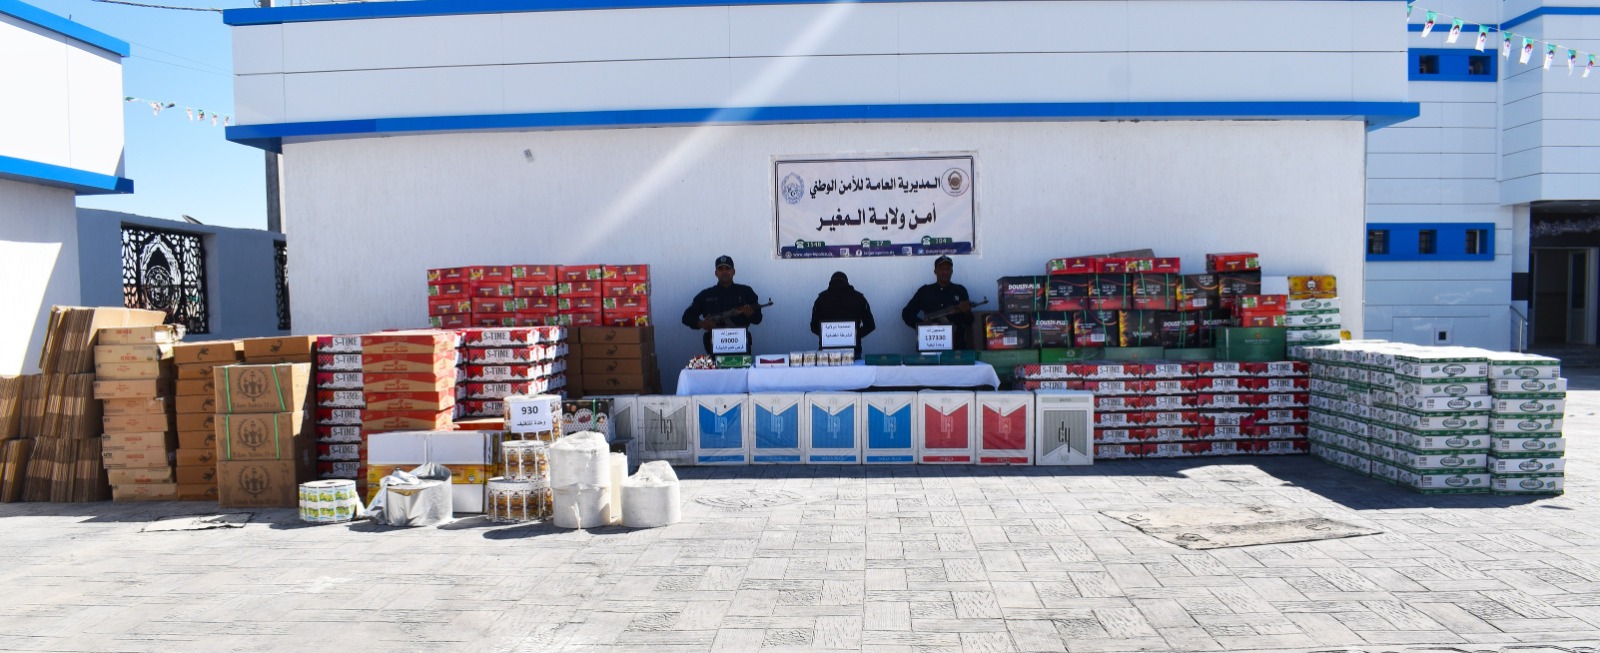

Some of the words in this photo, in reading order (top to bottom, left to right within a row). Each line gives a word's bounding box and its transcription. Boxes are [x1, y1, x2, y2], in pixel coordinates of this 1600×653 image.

[839, 175, 864, 195] للأمن
[866, 176, 896, 190] العامة
[899, 176, 941, 193] المديرية
[810, 178, 837, 200] الوطني
[816, 208, 866, 232] المغير
[868, 206, 906, 230] ولاية
[908, 202, 936, 230] أمن
[484, 332, 507, 340] S-TIME
[335, 337, 358, 346] S-TIME
[486, 350, 510, 358] S-TIME
[335, 356, 358, 364] S-TIME
[484, 366, 508, 375] S-TIME
[336, 374, 358, 382] S-TIME
[484, 384, 508, 392] S-TIME
[484, 402, 504, 410] S-TIM
[521, 406, 538, 414] 930
[334, 410, 356, 418] S-TIME
[333, 427, 355, 436] S-TIME
[332, 445, 354, 454] S-TIME
